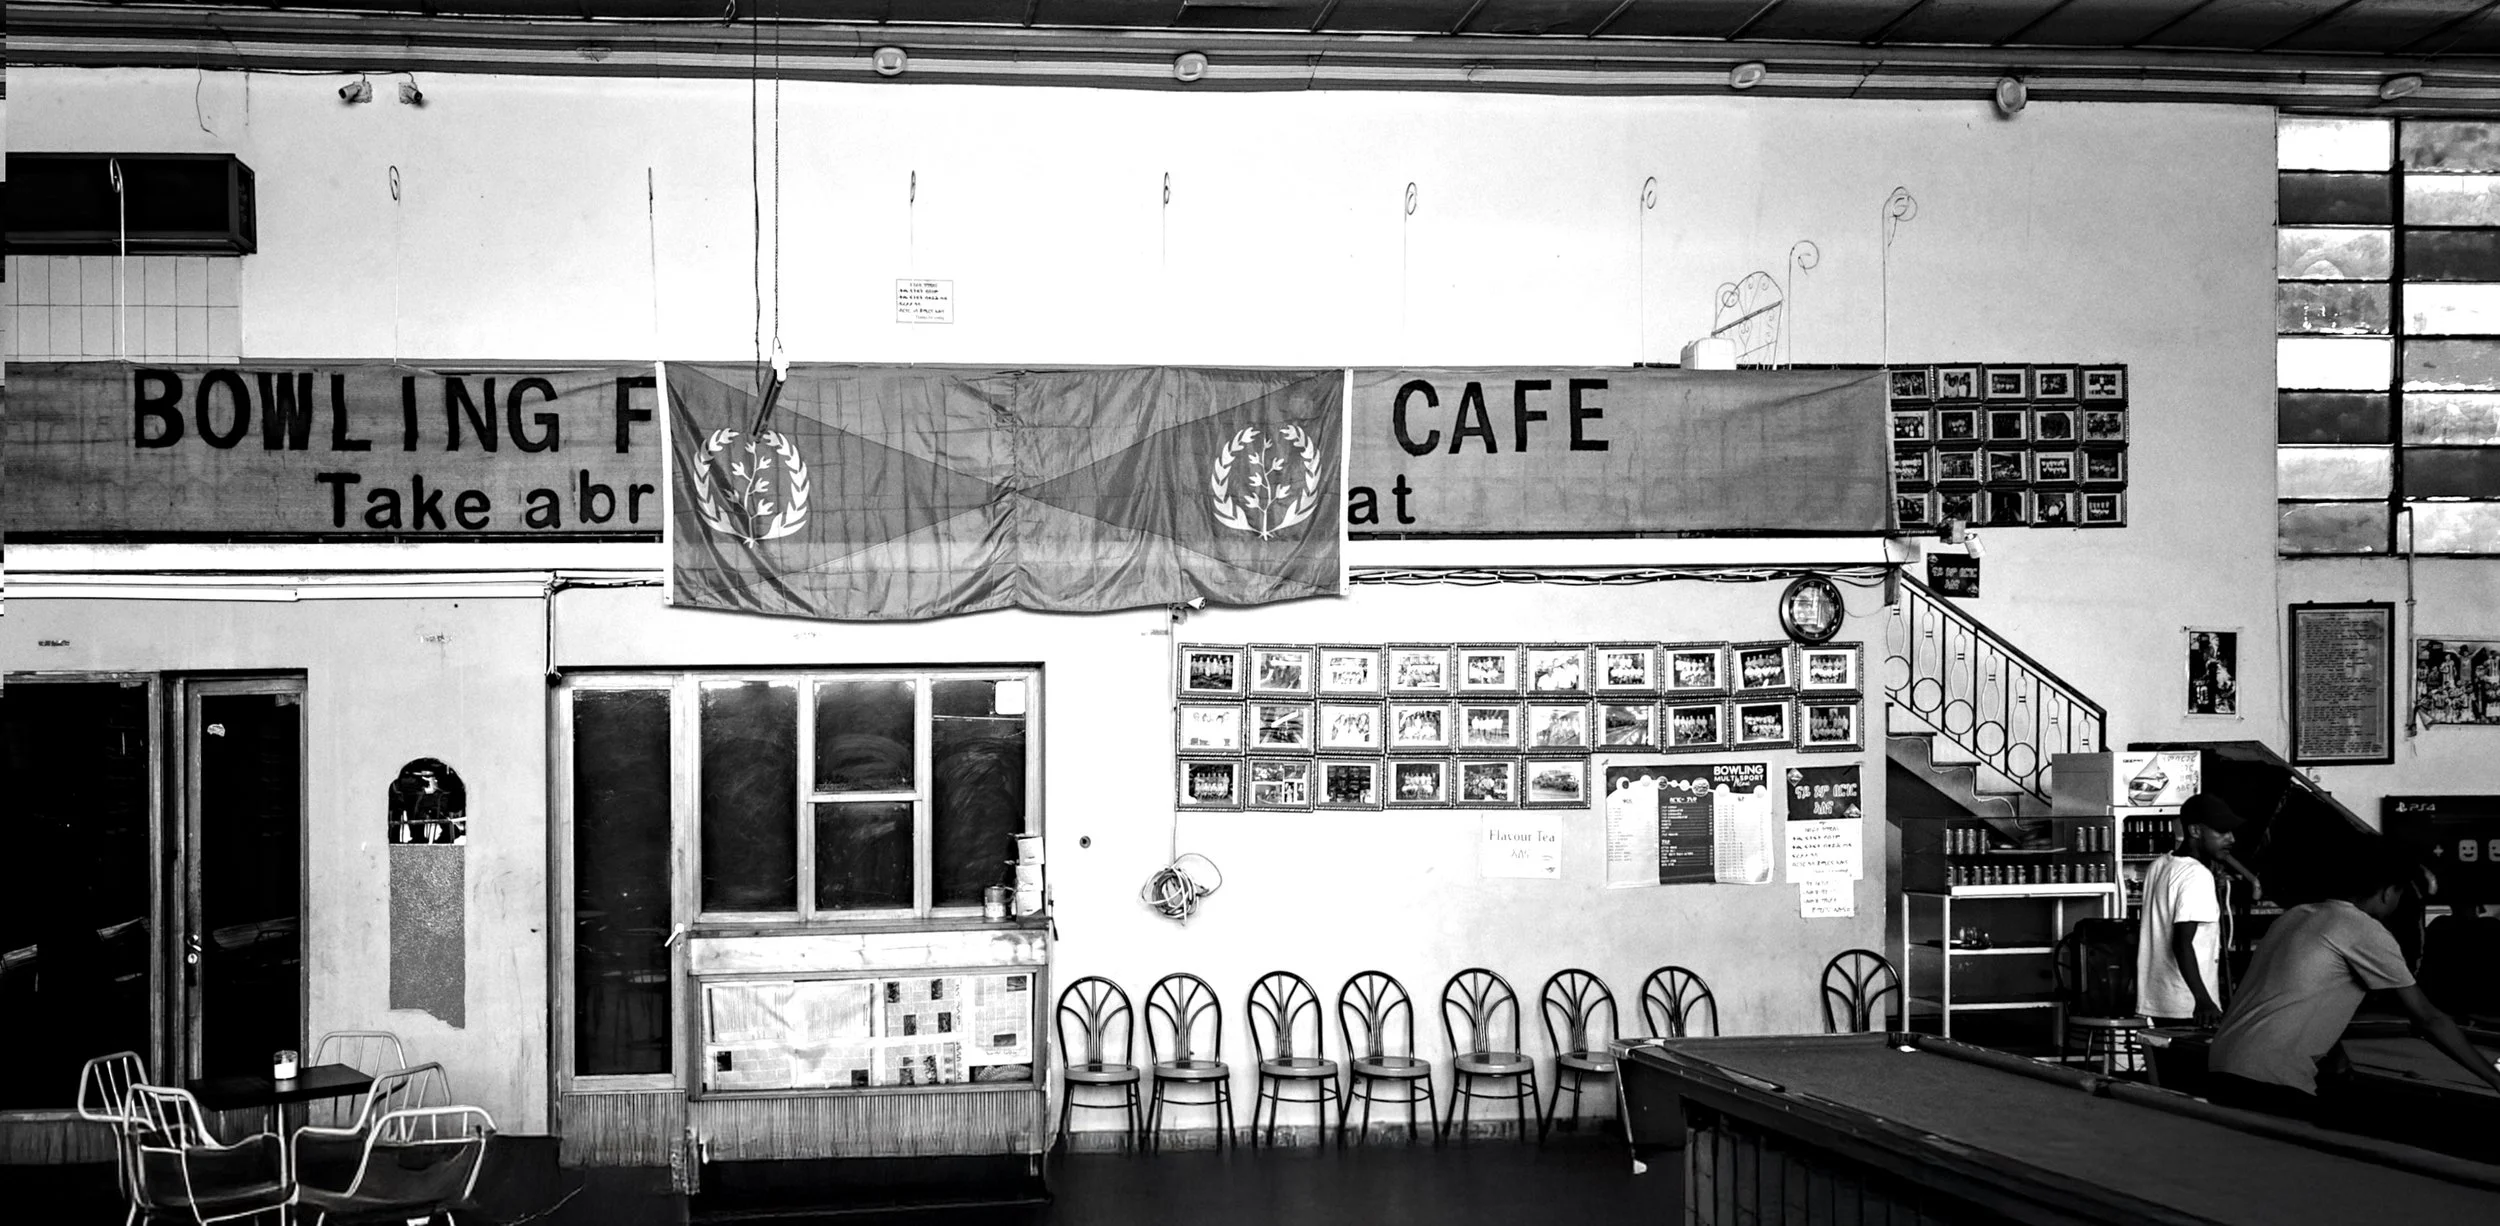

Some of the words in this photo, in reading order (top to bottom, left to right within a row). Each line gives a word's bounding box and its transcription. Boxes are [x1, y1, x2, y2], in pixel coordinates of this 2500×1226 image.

[133, 368, 560, 454] BOWLING
[1392, 378, 1610, 457] CAFE
[317, 471, 491, 530] Take
[1713, 765, 1764, 776] BOWLING
[1489, 829, 1532, 842] Flavour
[1537, 830, 1556, 842] Tea
